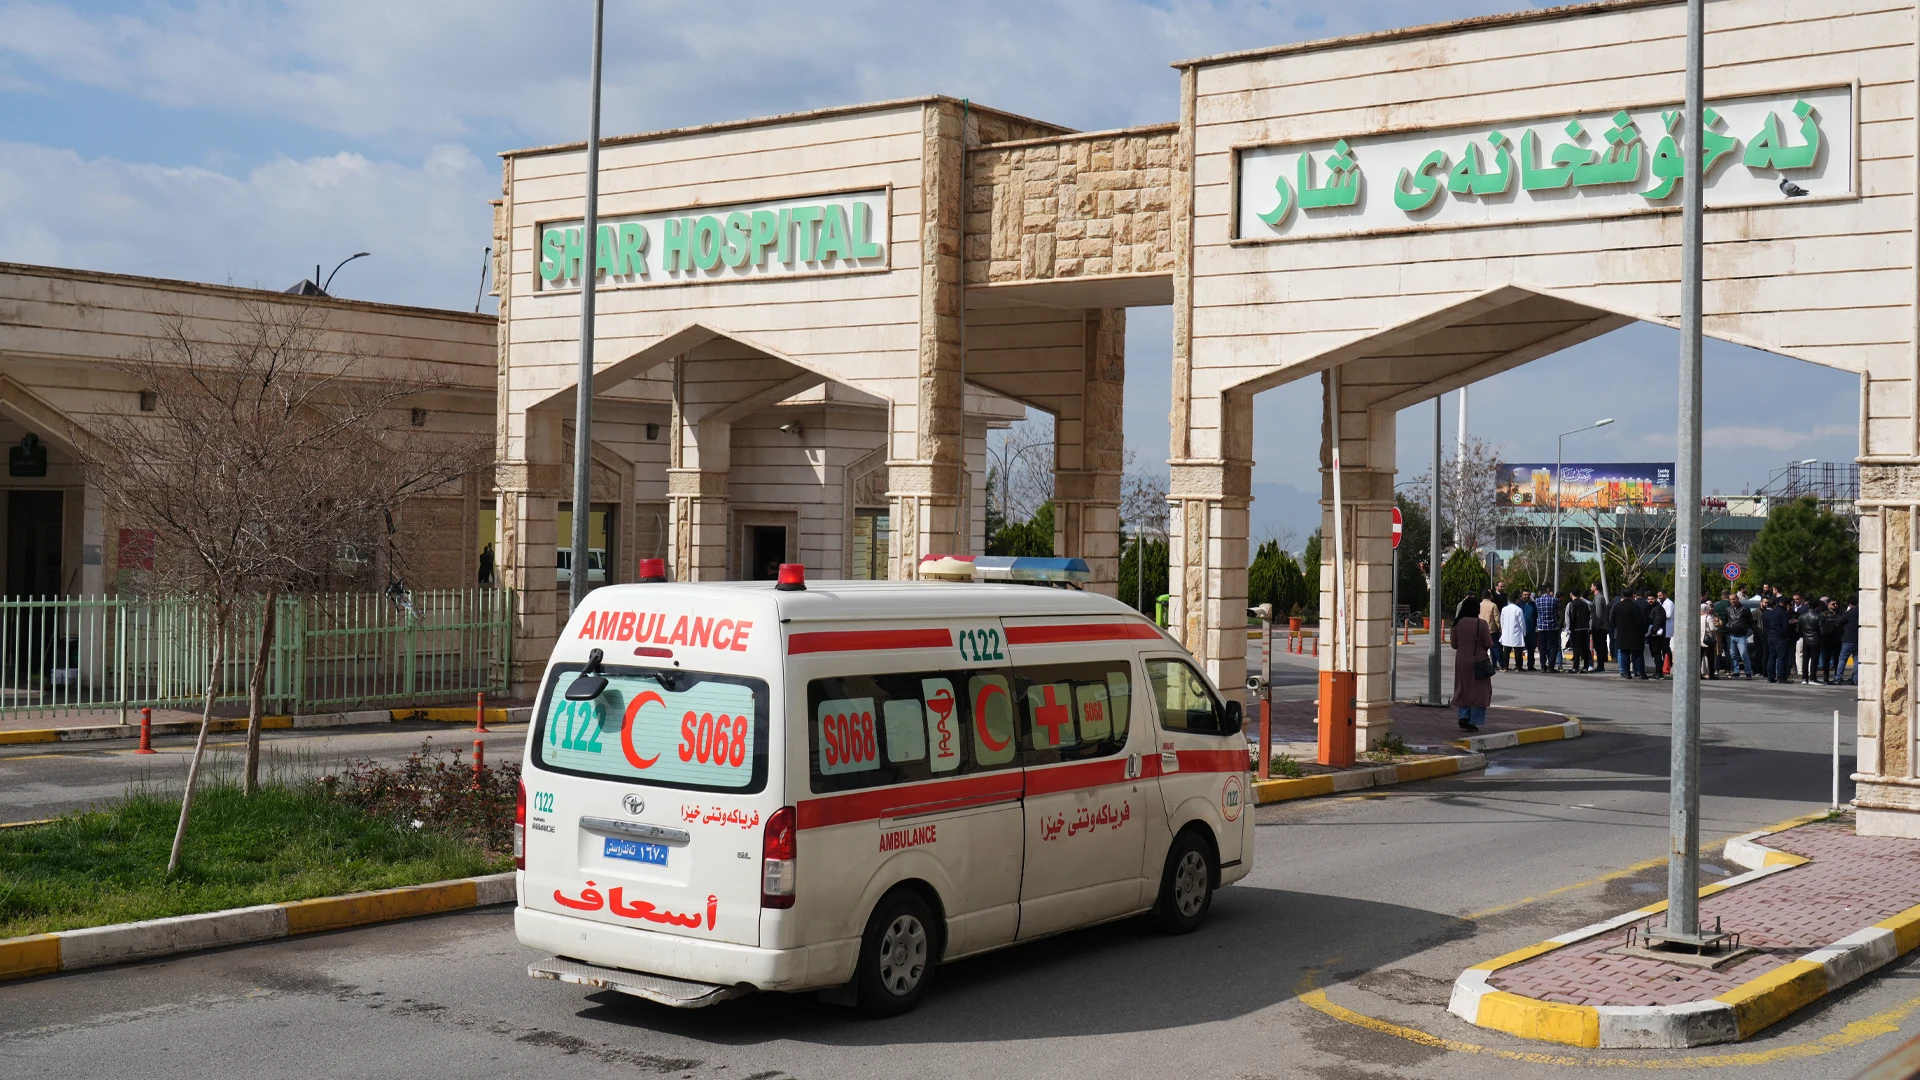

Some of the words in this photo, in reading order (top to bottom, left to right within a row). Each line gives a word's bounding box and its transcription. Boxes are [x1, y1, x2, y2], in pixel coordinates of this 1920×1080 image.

[1257, 139, 1365, 226] شار
[540, 223, 648, 281] SHAR
[663, 202, 881, 271] HOSPITAL
[578, 610, 753, 652] AMBULANCE
[968, 628, 1004, 662] 122
[1084, 701, 1105, 722] S068
[561, 700, 607, 753] 122
[678, 710, 748, 768] S068
[823, 711, 876, 767] S068
[538, 792, 554, 813] 122
[879, 824, 937, 853] AMBULANCE
